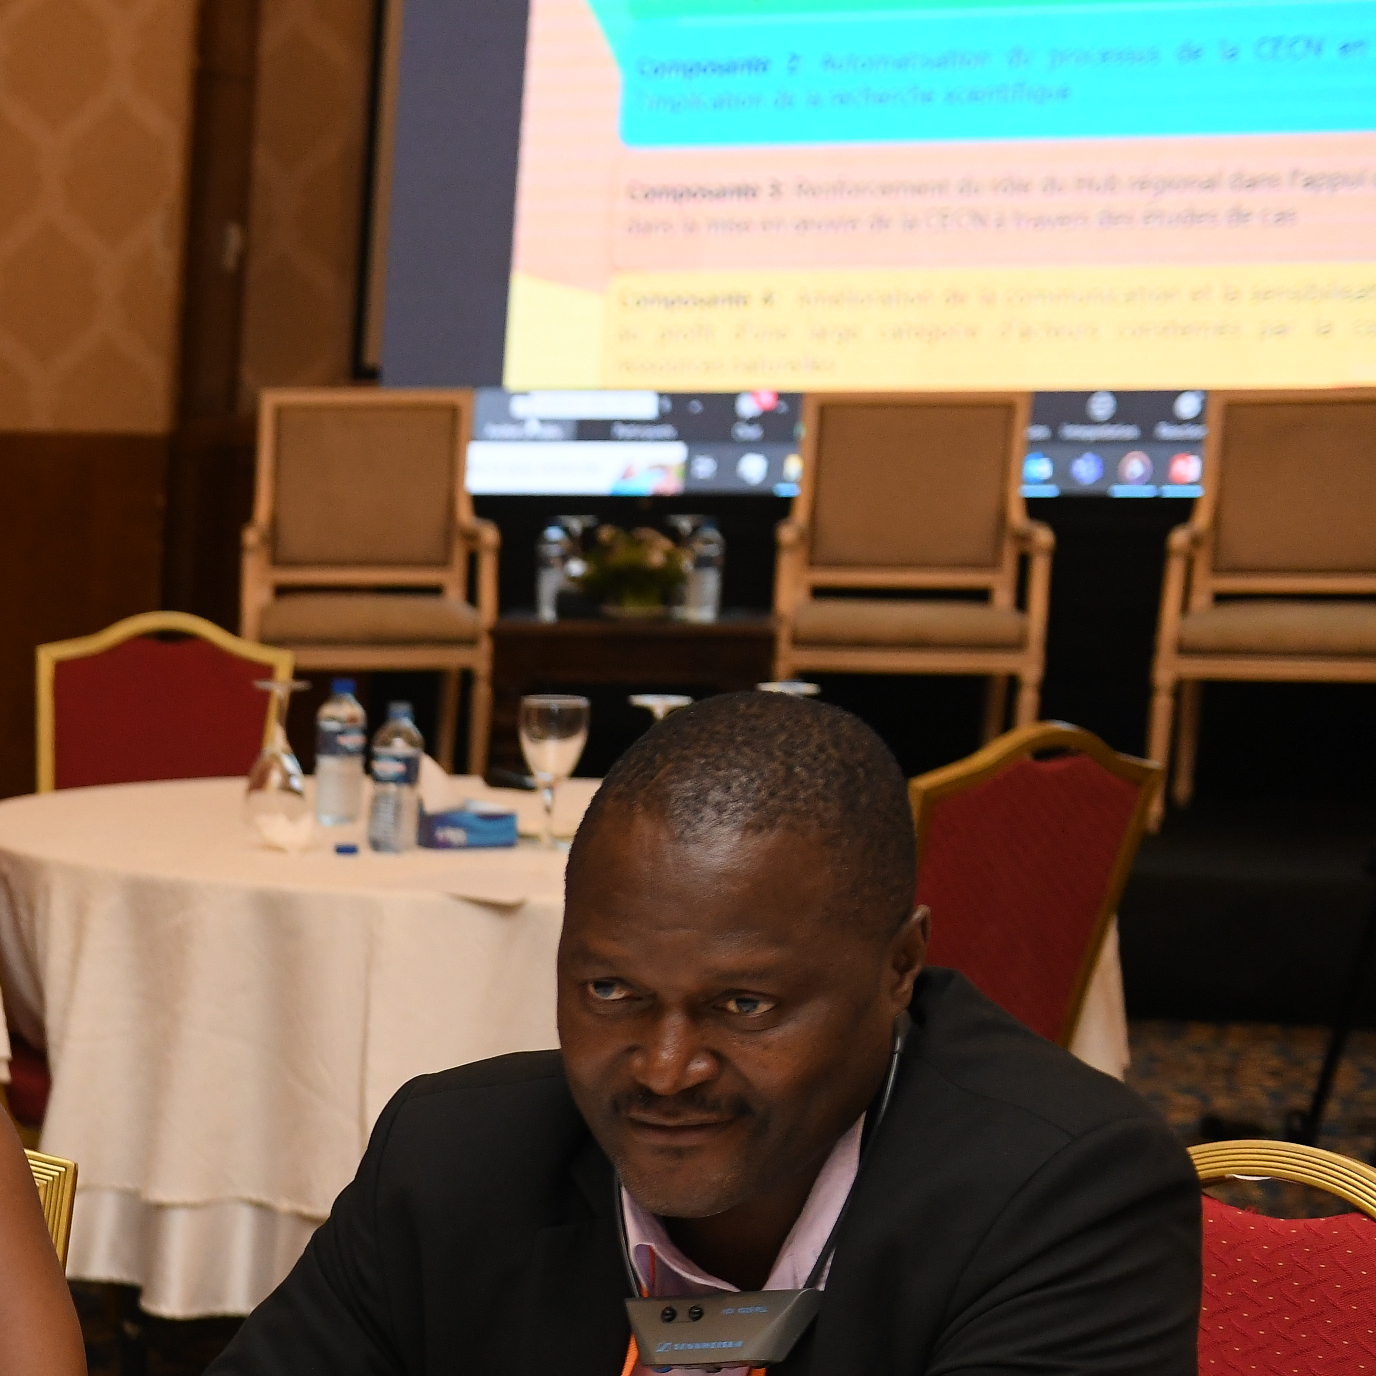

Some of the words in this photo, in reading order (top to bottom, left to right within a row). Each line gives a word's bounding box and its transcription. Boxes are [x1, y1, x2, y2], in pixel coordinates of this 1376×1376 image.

[635, 54, 772, 81] Composante
[1174, 41, 1205, 65] de
[1219, 39, 1241, 64] la
[626, 179, 761, 208] Composante
[1228, 166, 1282, 193] dans
[619, 286, 751, 311] Composante
